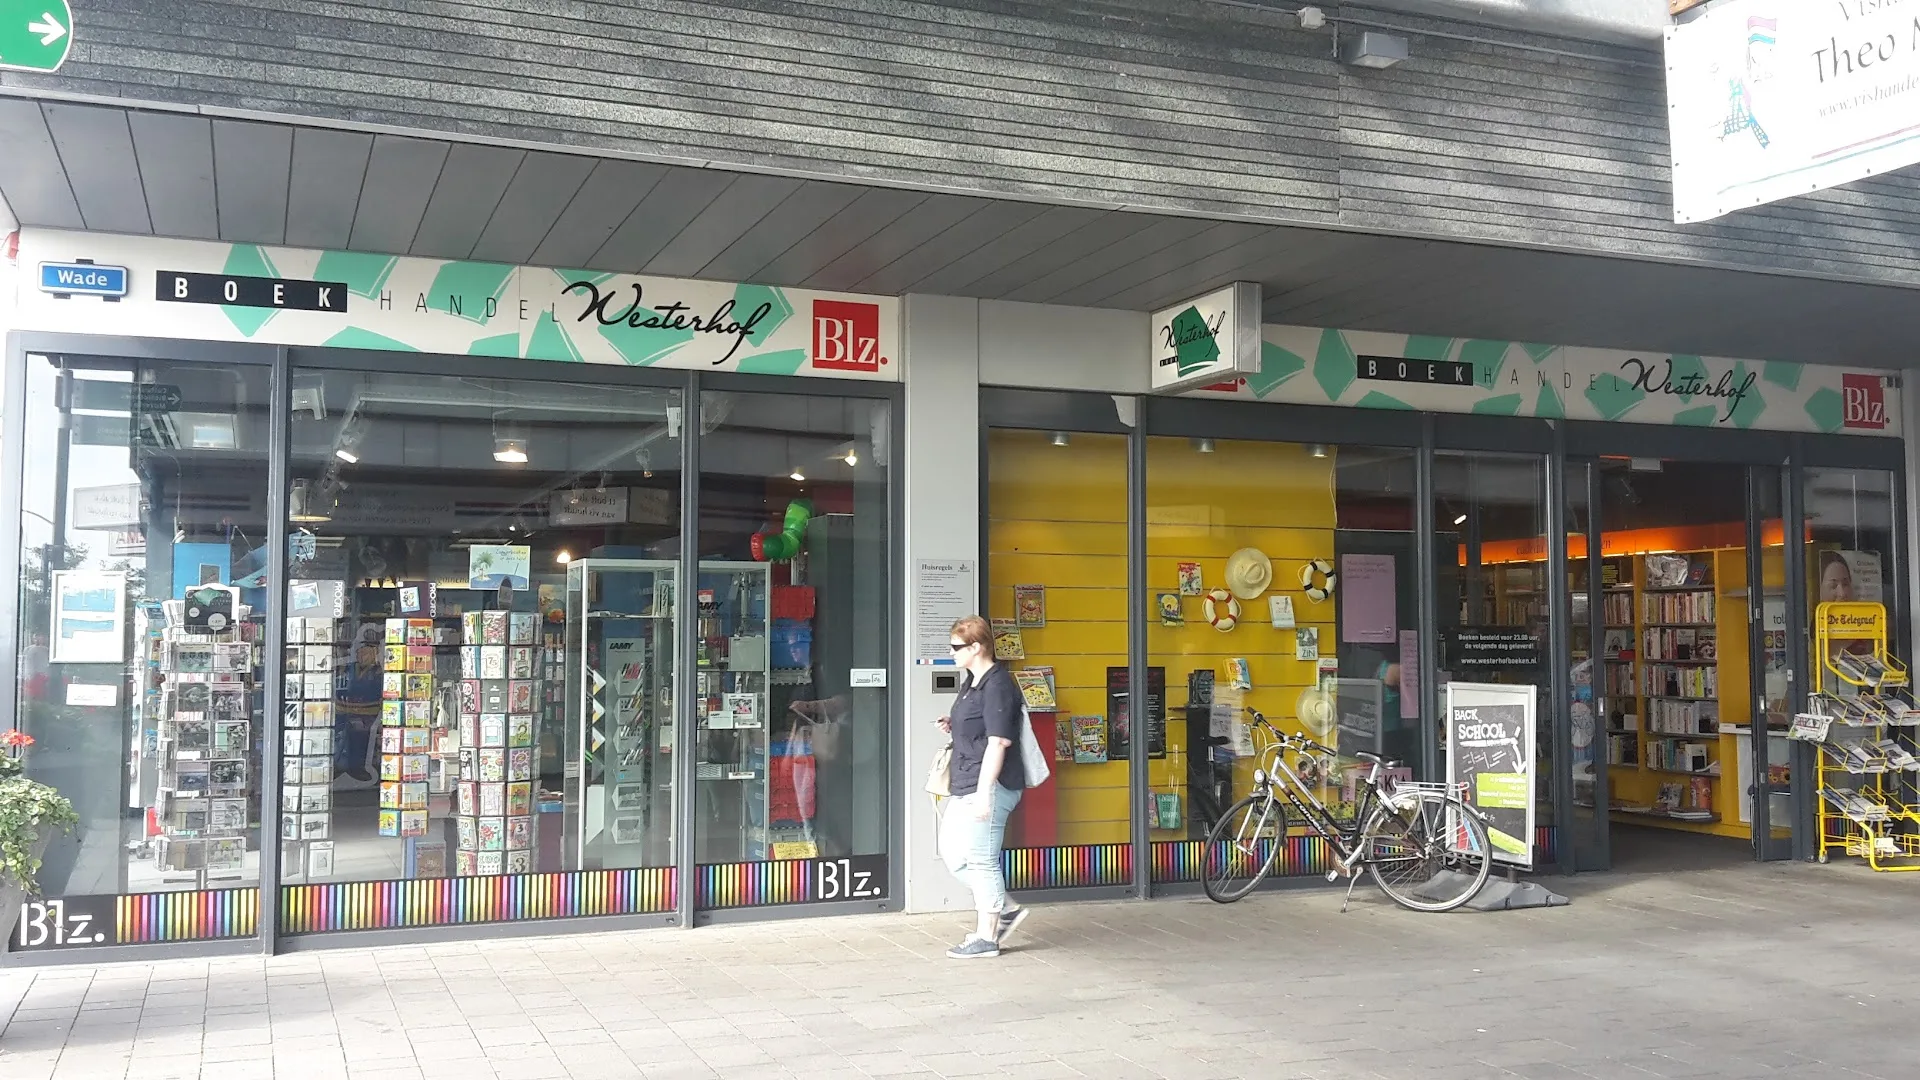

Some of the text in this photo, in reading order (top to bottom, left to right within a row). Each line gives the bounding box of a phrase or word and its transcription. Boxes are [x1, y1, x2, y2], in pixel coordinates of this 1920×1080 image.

[1811, 34, 1896, 84] Theo
[57, 269, 109, 287] Wade
[174, 277, 332, 308] BOEK
[561, 280, 772, 365] Westerhof
[1159, 310, 1226, 358] Westerhof
[813, 315, 888, 366] Blz.
[1368, 359, 1464, 383] BOEK
[1620, 358, 1756, 423] Westerhof
[1844, 386, 1891, 424] Blz.
[1458, 633, 1479, 641] Boeken
[1480, 633, 1500, 641] besteld
[1840, 613, 1877, 627] Telegraaf
[609, 642, 634, 650] LAMY
[1473, 643, 1498, 651] volgende
[1498, 643, 1508, 651] dag
[1454, 709, 1479, 721] BACK
[1458, 723, 1506, 740] SCHOOL
[818, 858, 882, 900] Blz.
[20, 899, 106, 946] Blz.
